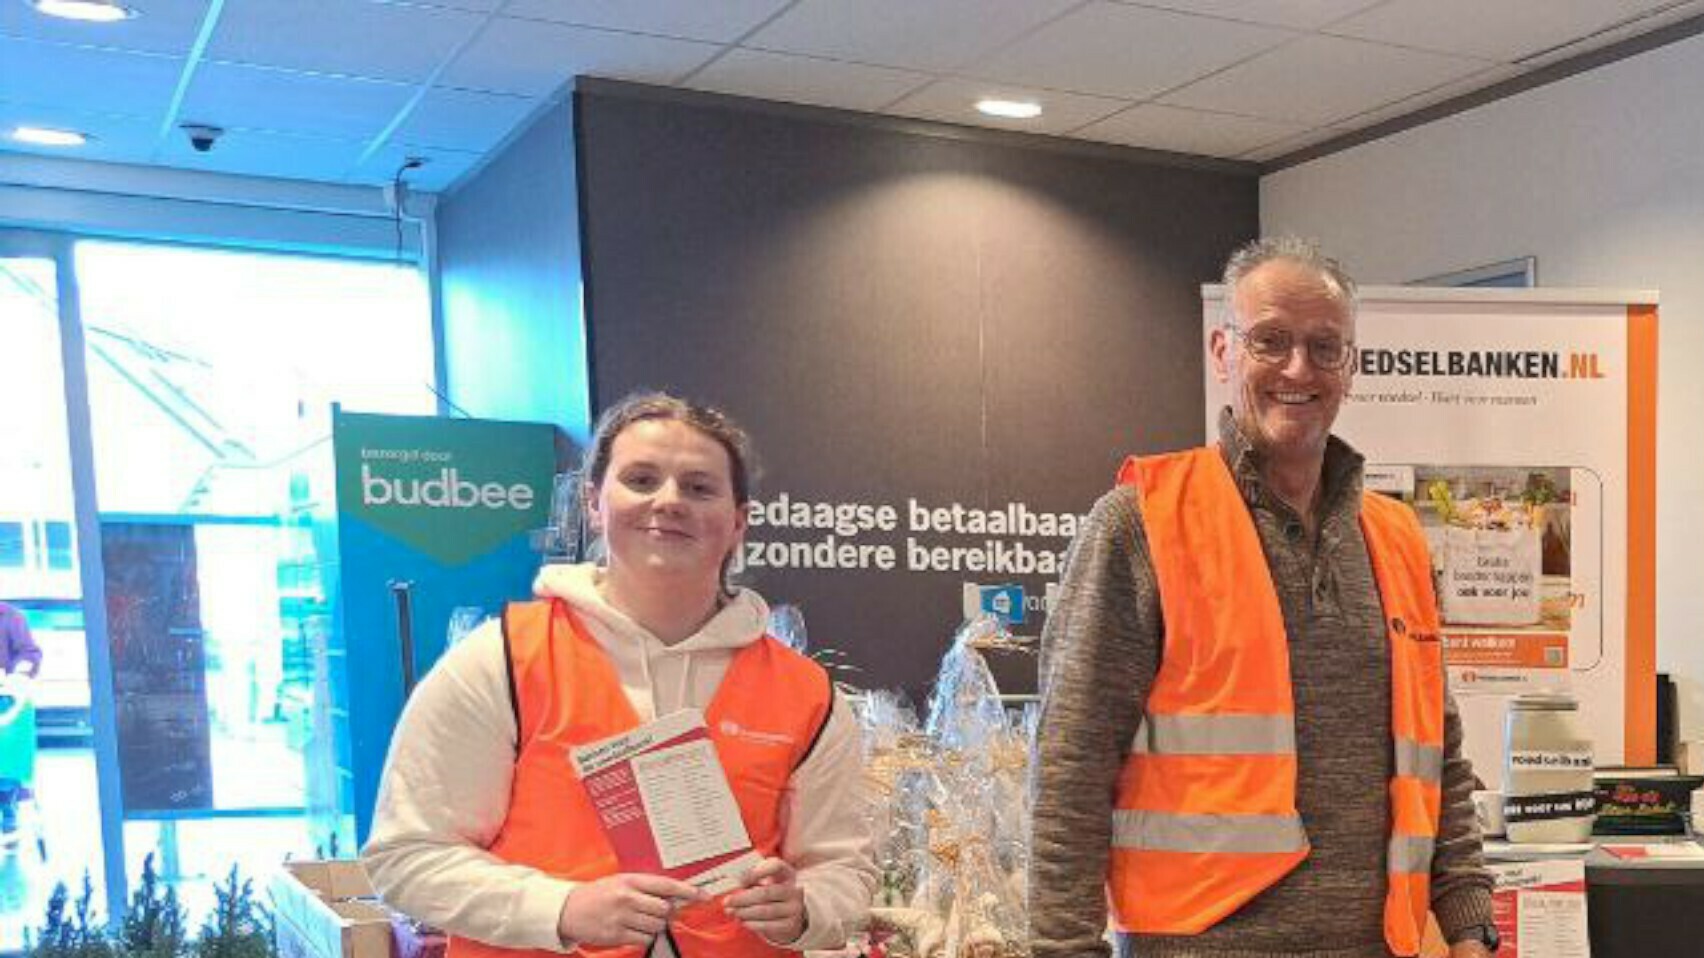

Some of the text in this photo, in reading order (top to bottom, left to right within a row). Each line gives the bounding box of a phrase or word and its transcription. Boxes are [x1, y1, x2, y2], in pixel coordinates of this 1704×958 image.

[1352, 349, 1606, 379] EDSELBANKEN.NL
[361, 462, 535, 510] budbee
[747, 493, 898, 537] edaagse
[728, 535, 896, 575] jzondere
